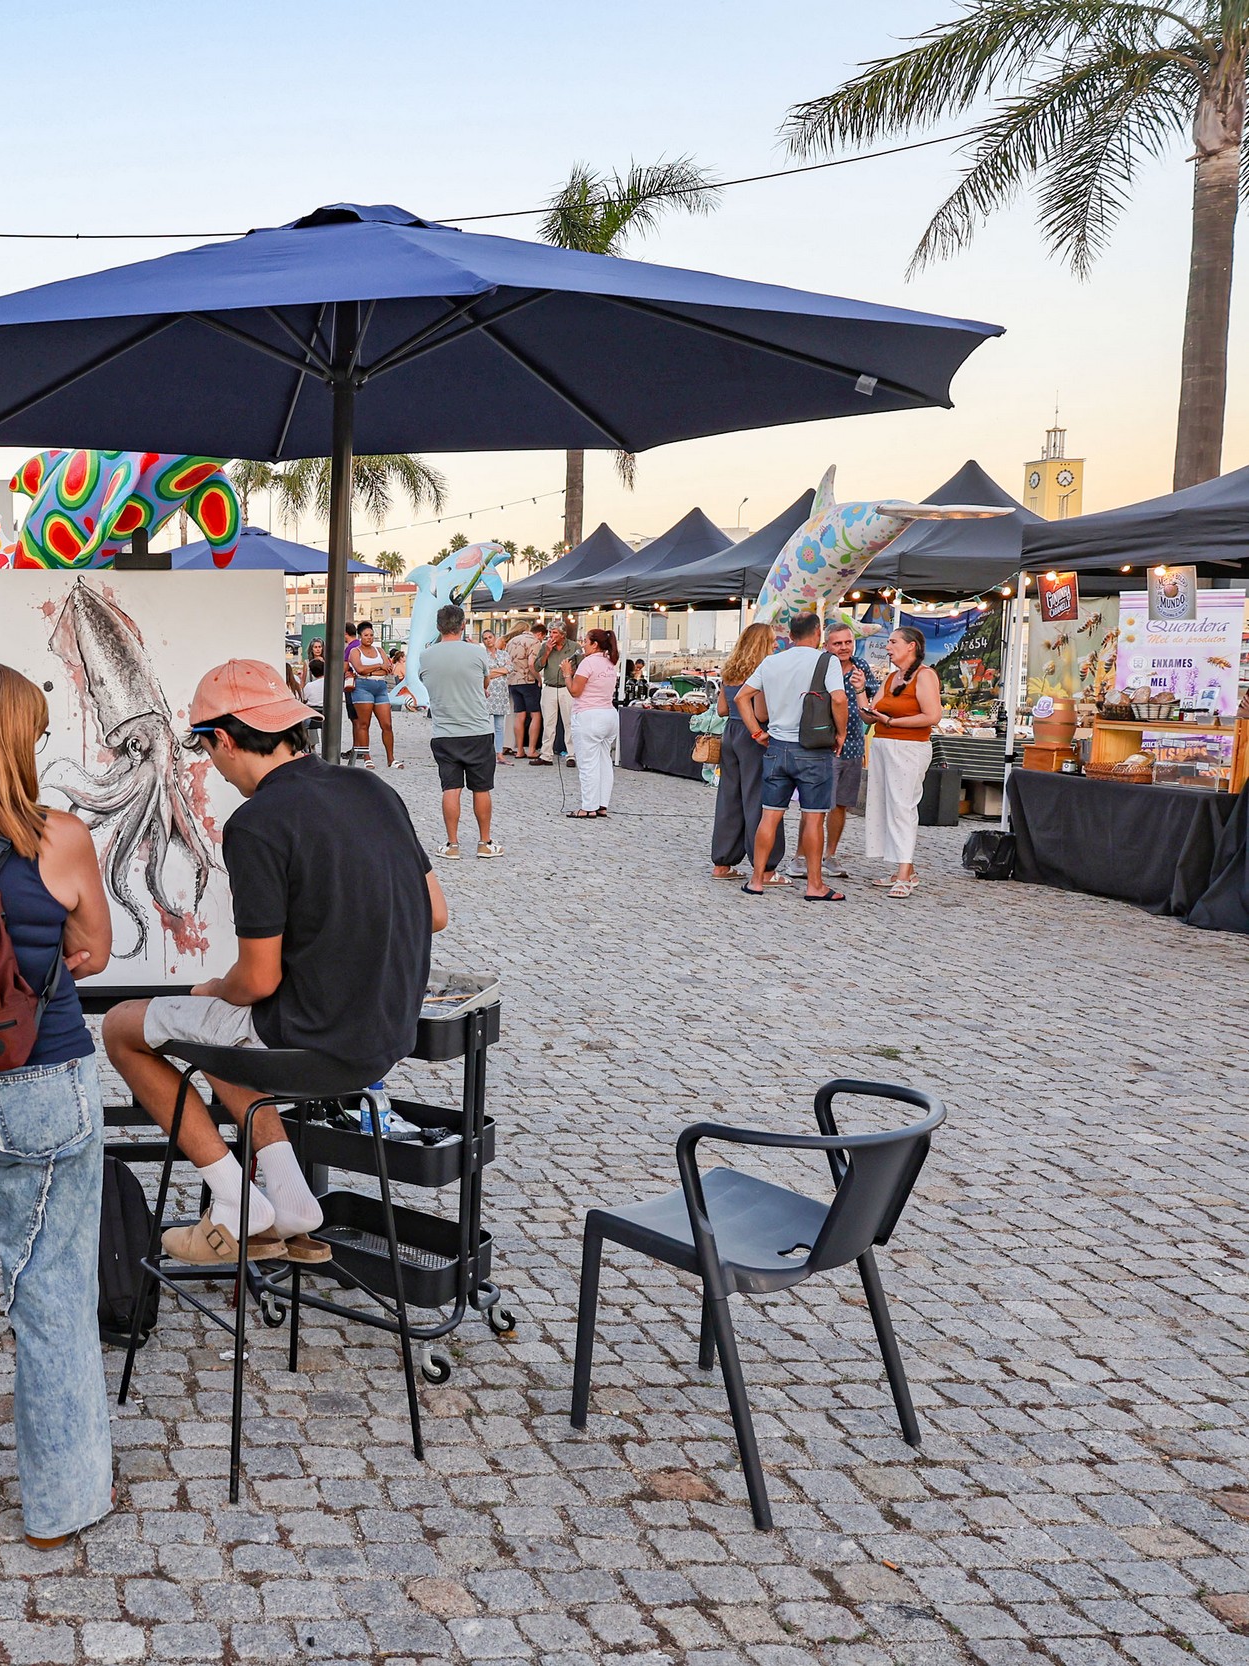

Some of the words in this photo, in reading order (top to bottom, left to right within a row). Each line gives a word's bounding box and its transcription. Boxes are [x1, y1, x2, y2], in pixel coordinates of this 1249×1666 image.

[1159, 594, 1186, 609] MUNDO
[1146, 617, 1230, 633] Quendera
[1147, 634, 1168, 644] Mel
[1172, 635, 1184, 643] do
[1186, 634, 1227, 645] produtor
[1151, 658, 1193, 668] ENXAMES
[1150, 677, 1168, 687] MEL
